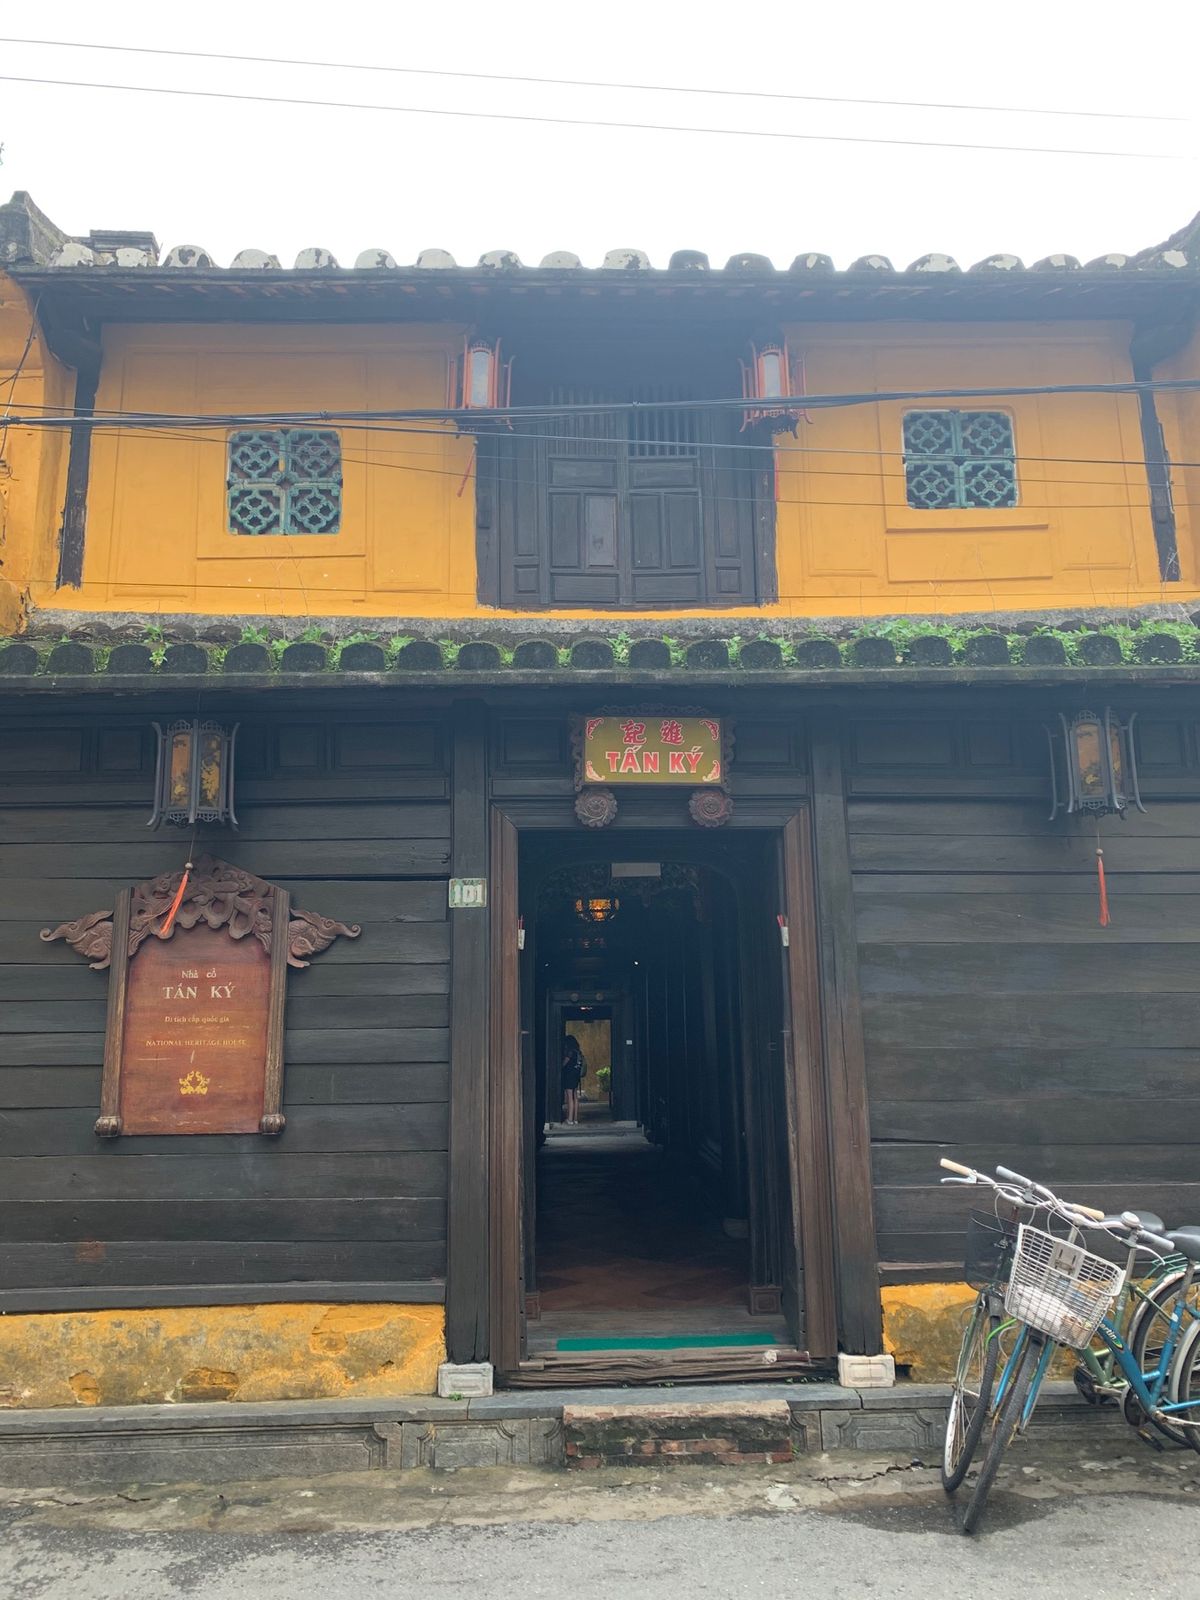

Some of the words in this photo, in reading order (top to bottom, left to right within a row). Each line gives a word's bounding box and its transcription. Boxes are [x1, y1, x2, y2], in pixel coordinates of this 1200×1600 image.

[605, 745, 660, 773] TẤN
[669, 745, 704, 773] KÝ
[454, 884, 483, 903] 101
[162, 983, 198, 999] TẤN
[210, 981, 236, 999] KÝ
